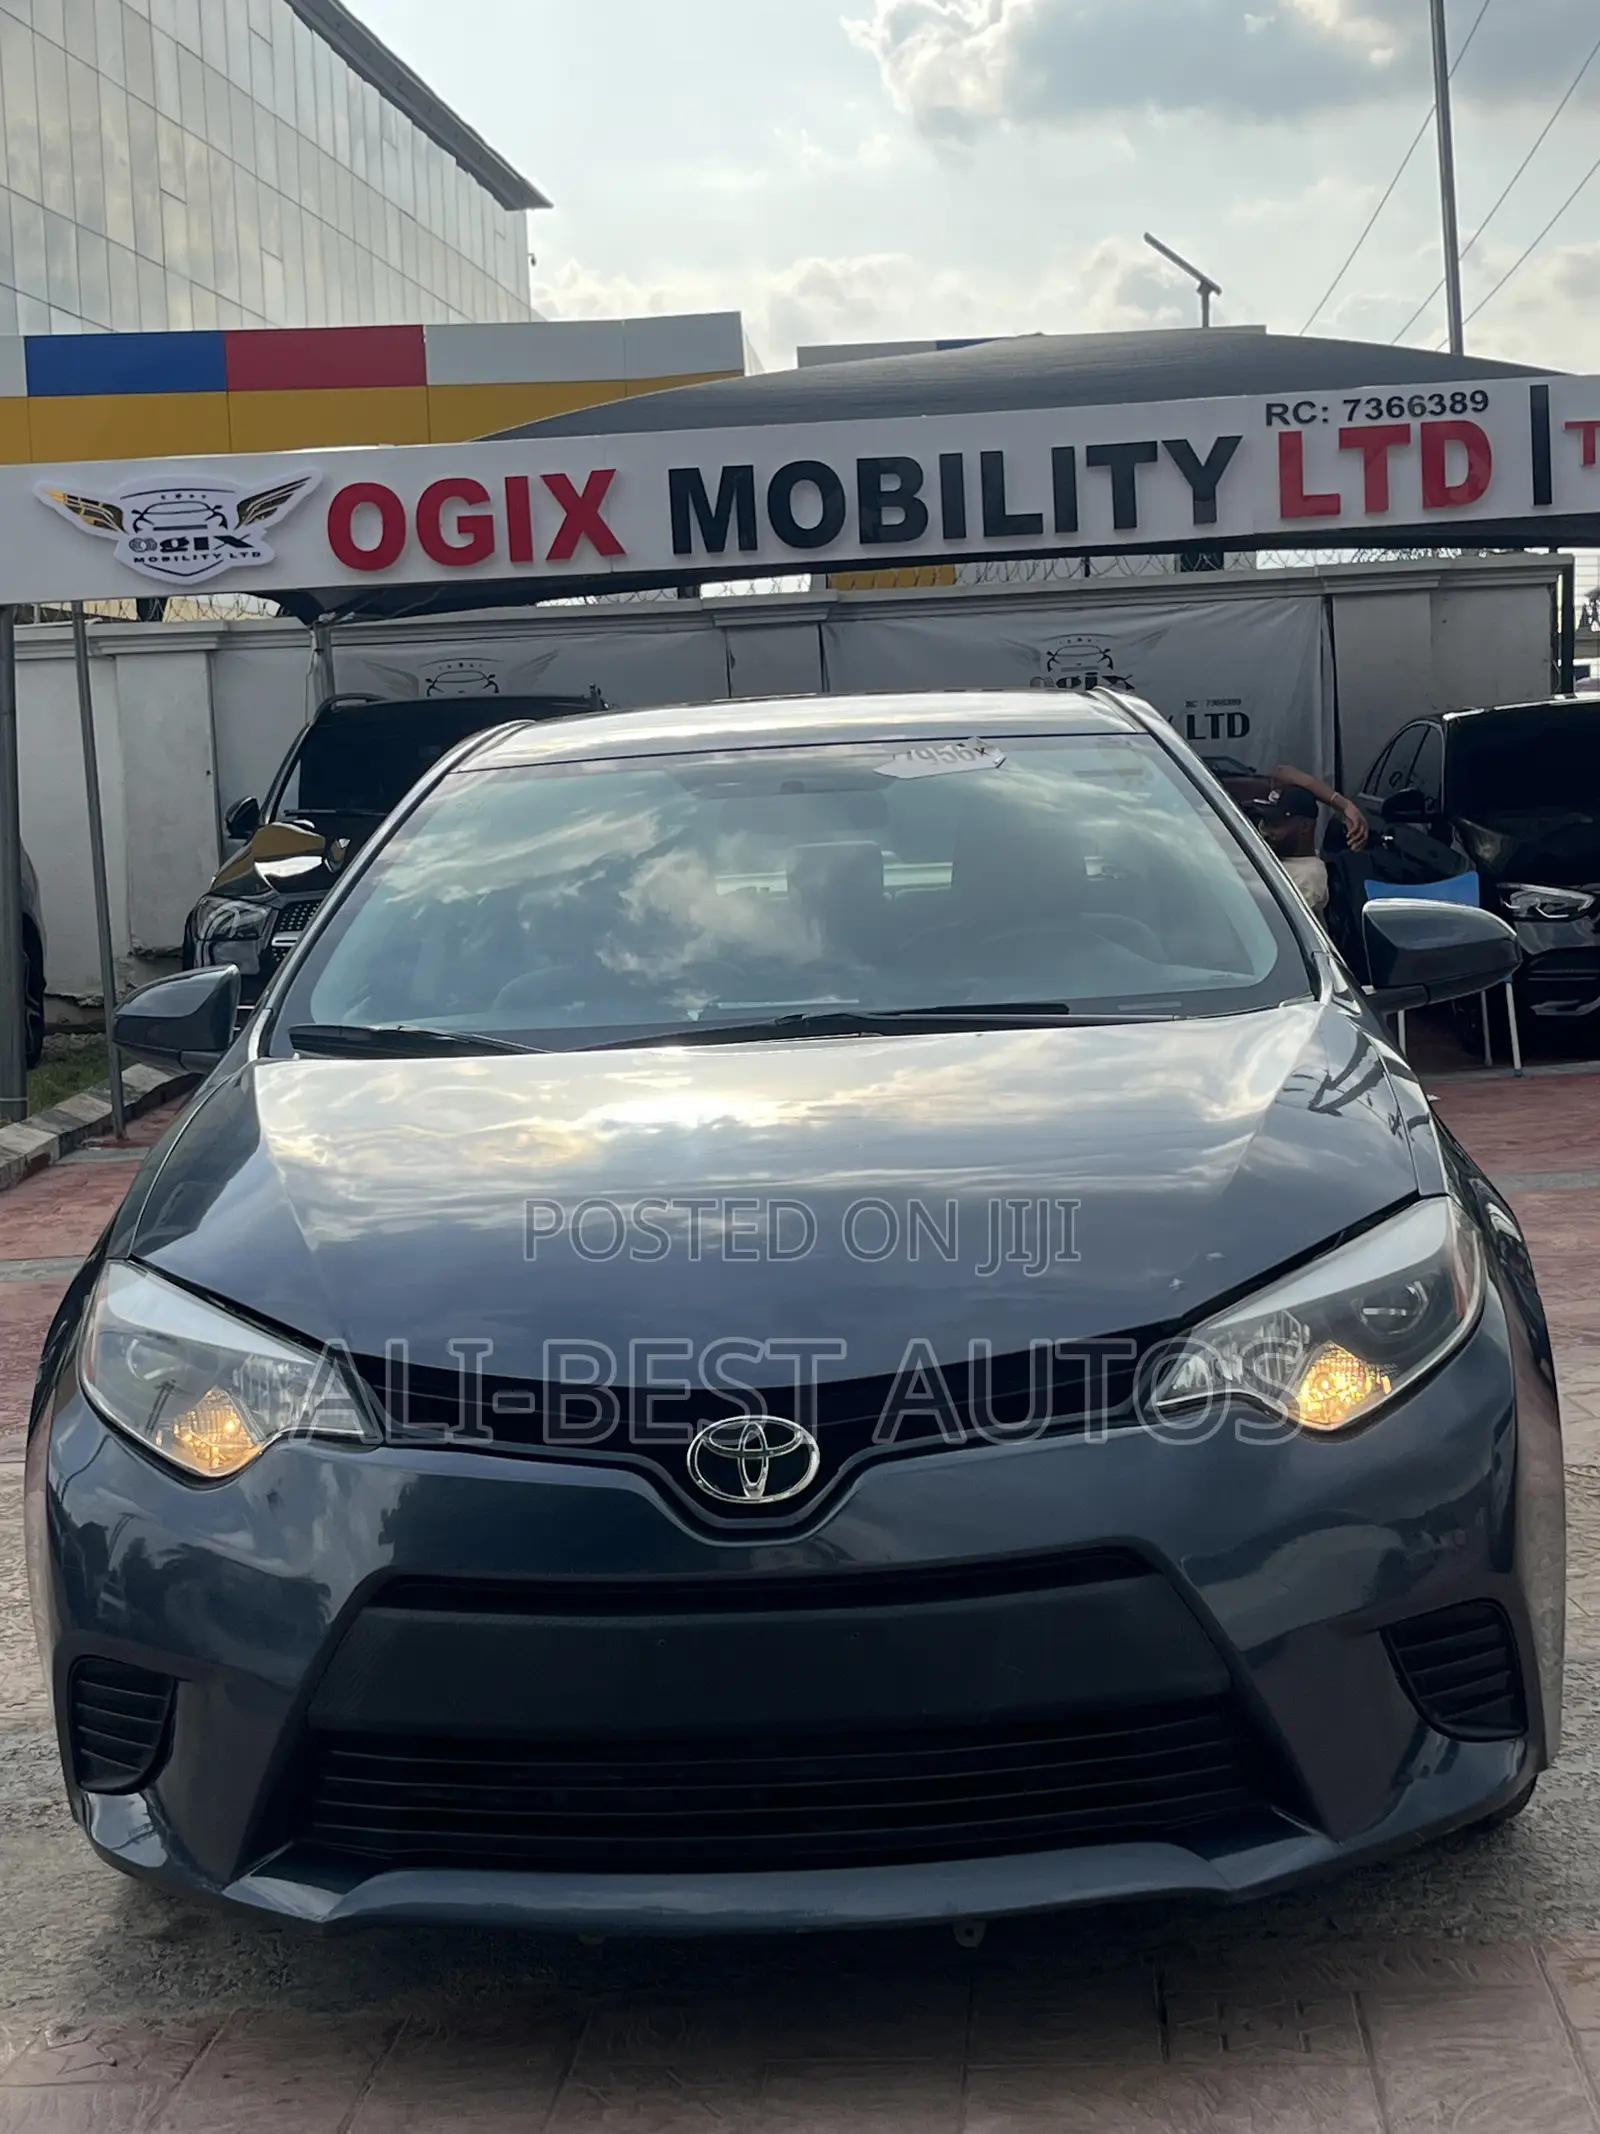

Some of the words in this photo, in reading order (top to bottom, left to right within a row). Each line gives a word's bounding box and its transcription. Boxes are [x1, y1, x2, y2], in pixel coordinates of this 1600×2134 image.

[1265, 401, 1329, 427] RC:
[1342, 390, 1489, 422] 7366389
[328, 468, 626, 571] OGIX
[668, 435, 1243, 555] MOBILITY
[1278, 420, 1492, 519] LTD
[133, 552, 222, 563] MOBILITY
[229, 551, 262, 559] LTD
[1187, 712, 1250, 740] LTD
